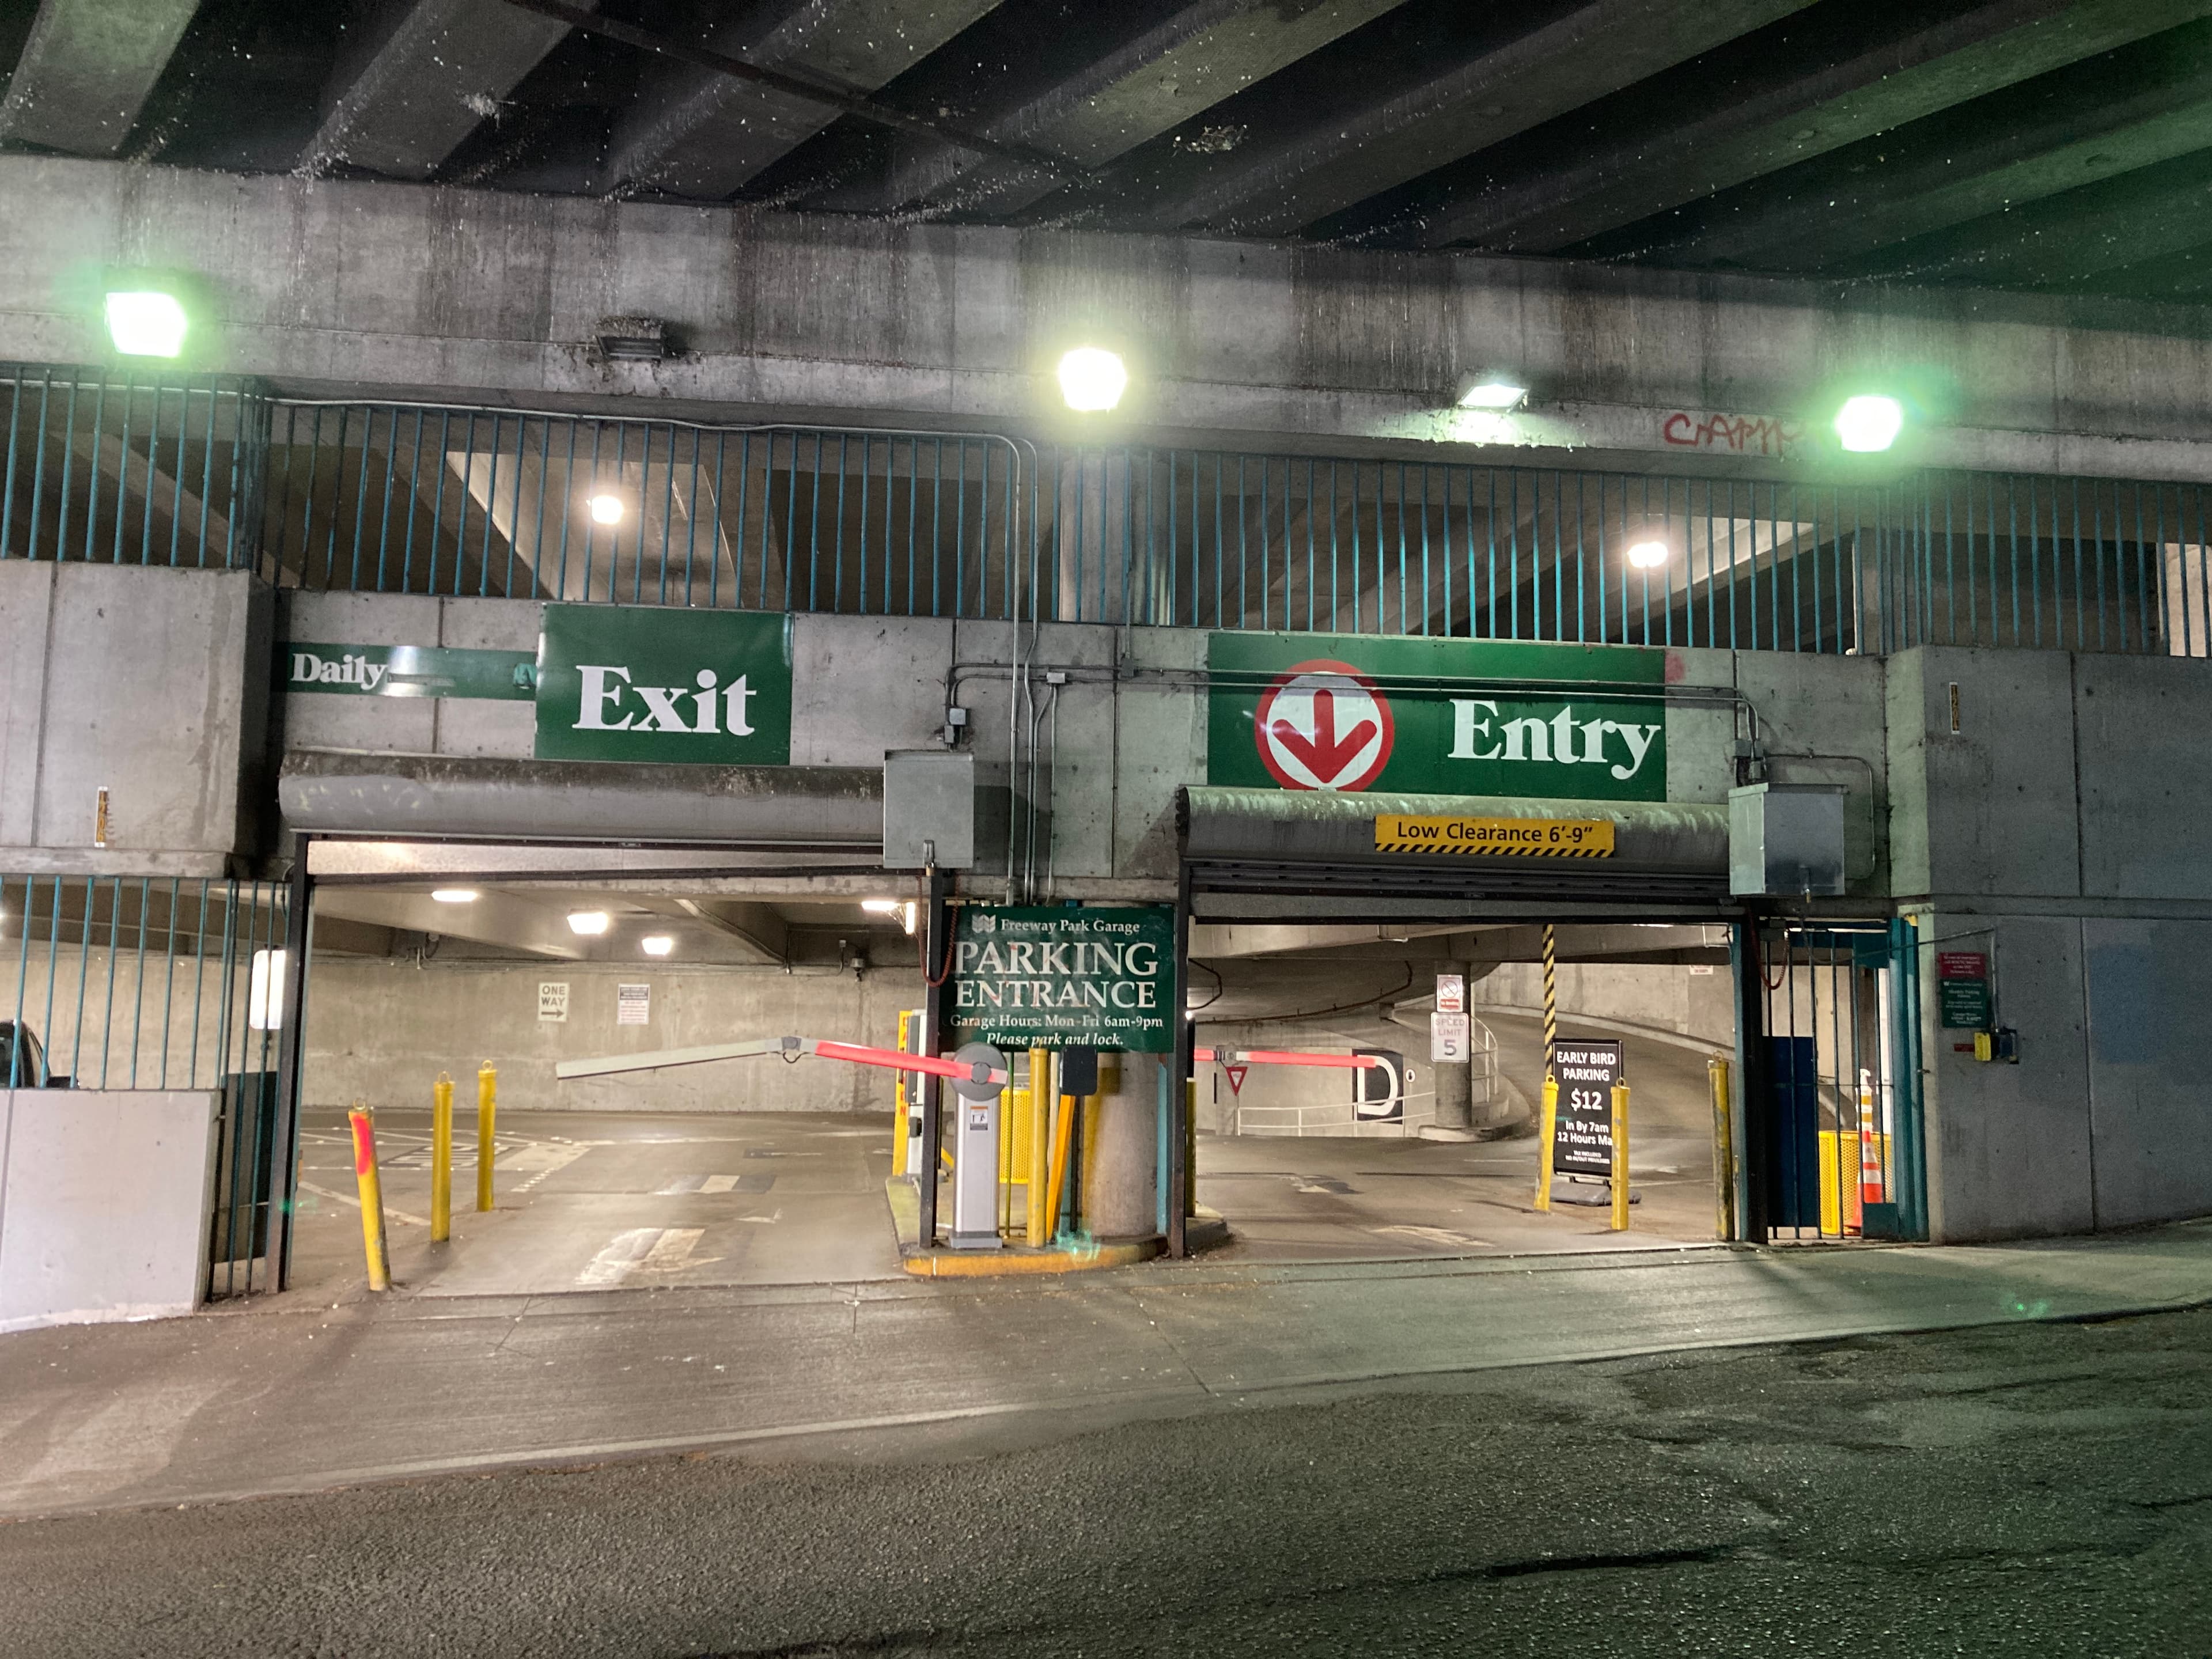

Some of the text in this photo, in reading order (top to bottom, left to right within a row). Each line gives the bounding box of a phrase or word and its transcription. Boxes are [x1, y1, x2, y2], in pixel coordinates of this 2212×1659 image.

[291, 653, 388, 691] Daily
[572, 665, 756, 737] Exit
[1448, 699, 1661, 780] Entry
[1397, 822, 1438, 838] Low
[1447, 822, 1542, 843] Clearance
[1001, 919, 1140, 934] Freeway Park Garage
[956, 942, 1158, 976] PARKING
[542, 985, 566, 995] ONE
[955, 980, 1157, 1008] ENTRANCE
[541, 997, 565, 1006] WAY
[950, 1014, 995, 1029] Garage
[999, 1015, 1041, 1028] Hours:
[1105, 1016, 1162, 1030] 6am-9pm
[987, 1033, 1123, 1047] Please park and lock.
[1444, 1040, 1457, 1056] 5
[1556, 1051, 1616, 1065] EARLY BIRD
[1563, 1068, 1610, 1081] PARKING
[1357, 1055, 1398, 1115] D
[1571, 1088, 1602, 1111] $12
[1566, 1120, 1609, 1134] In By 7am
[1558, 1131, 1612, 1146] 12 Hours Ma
